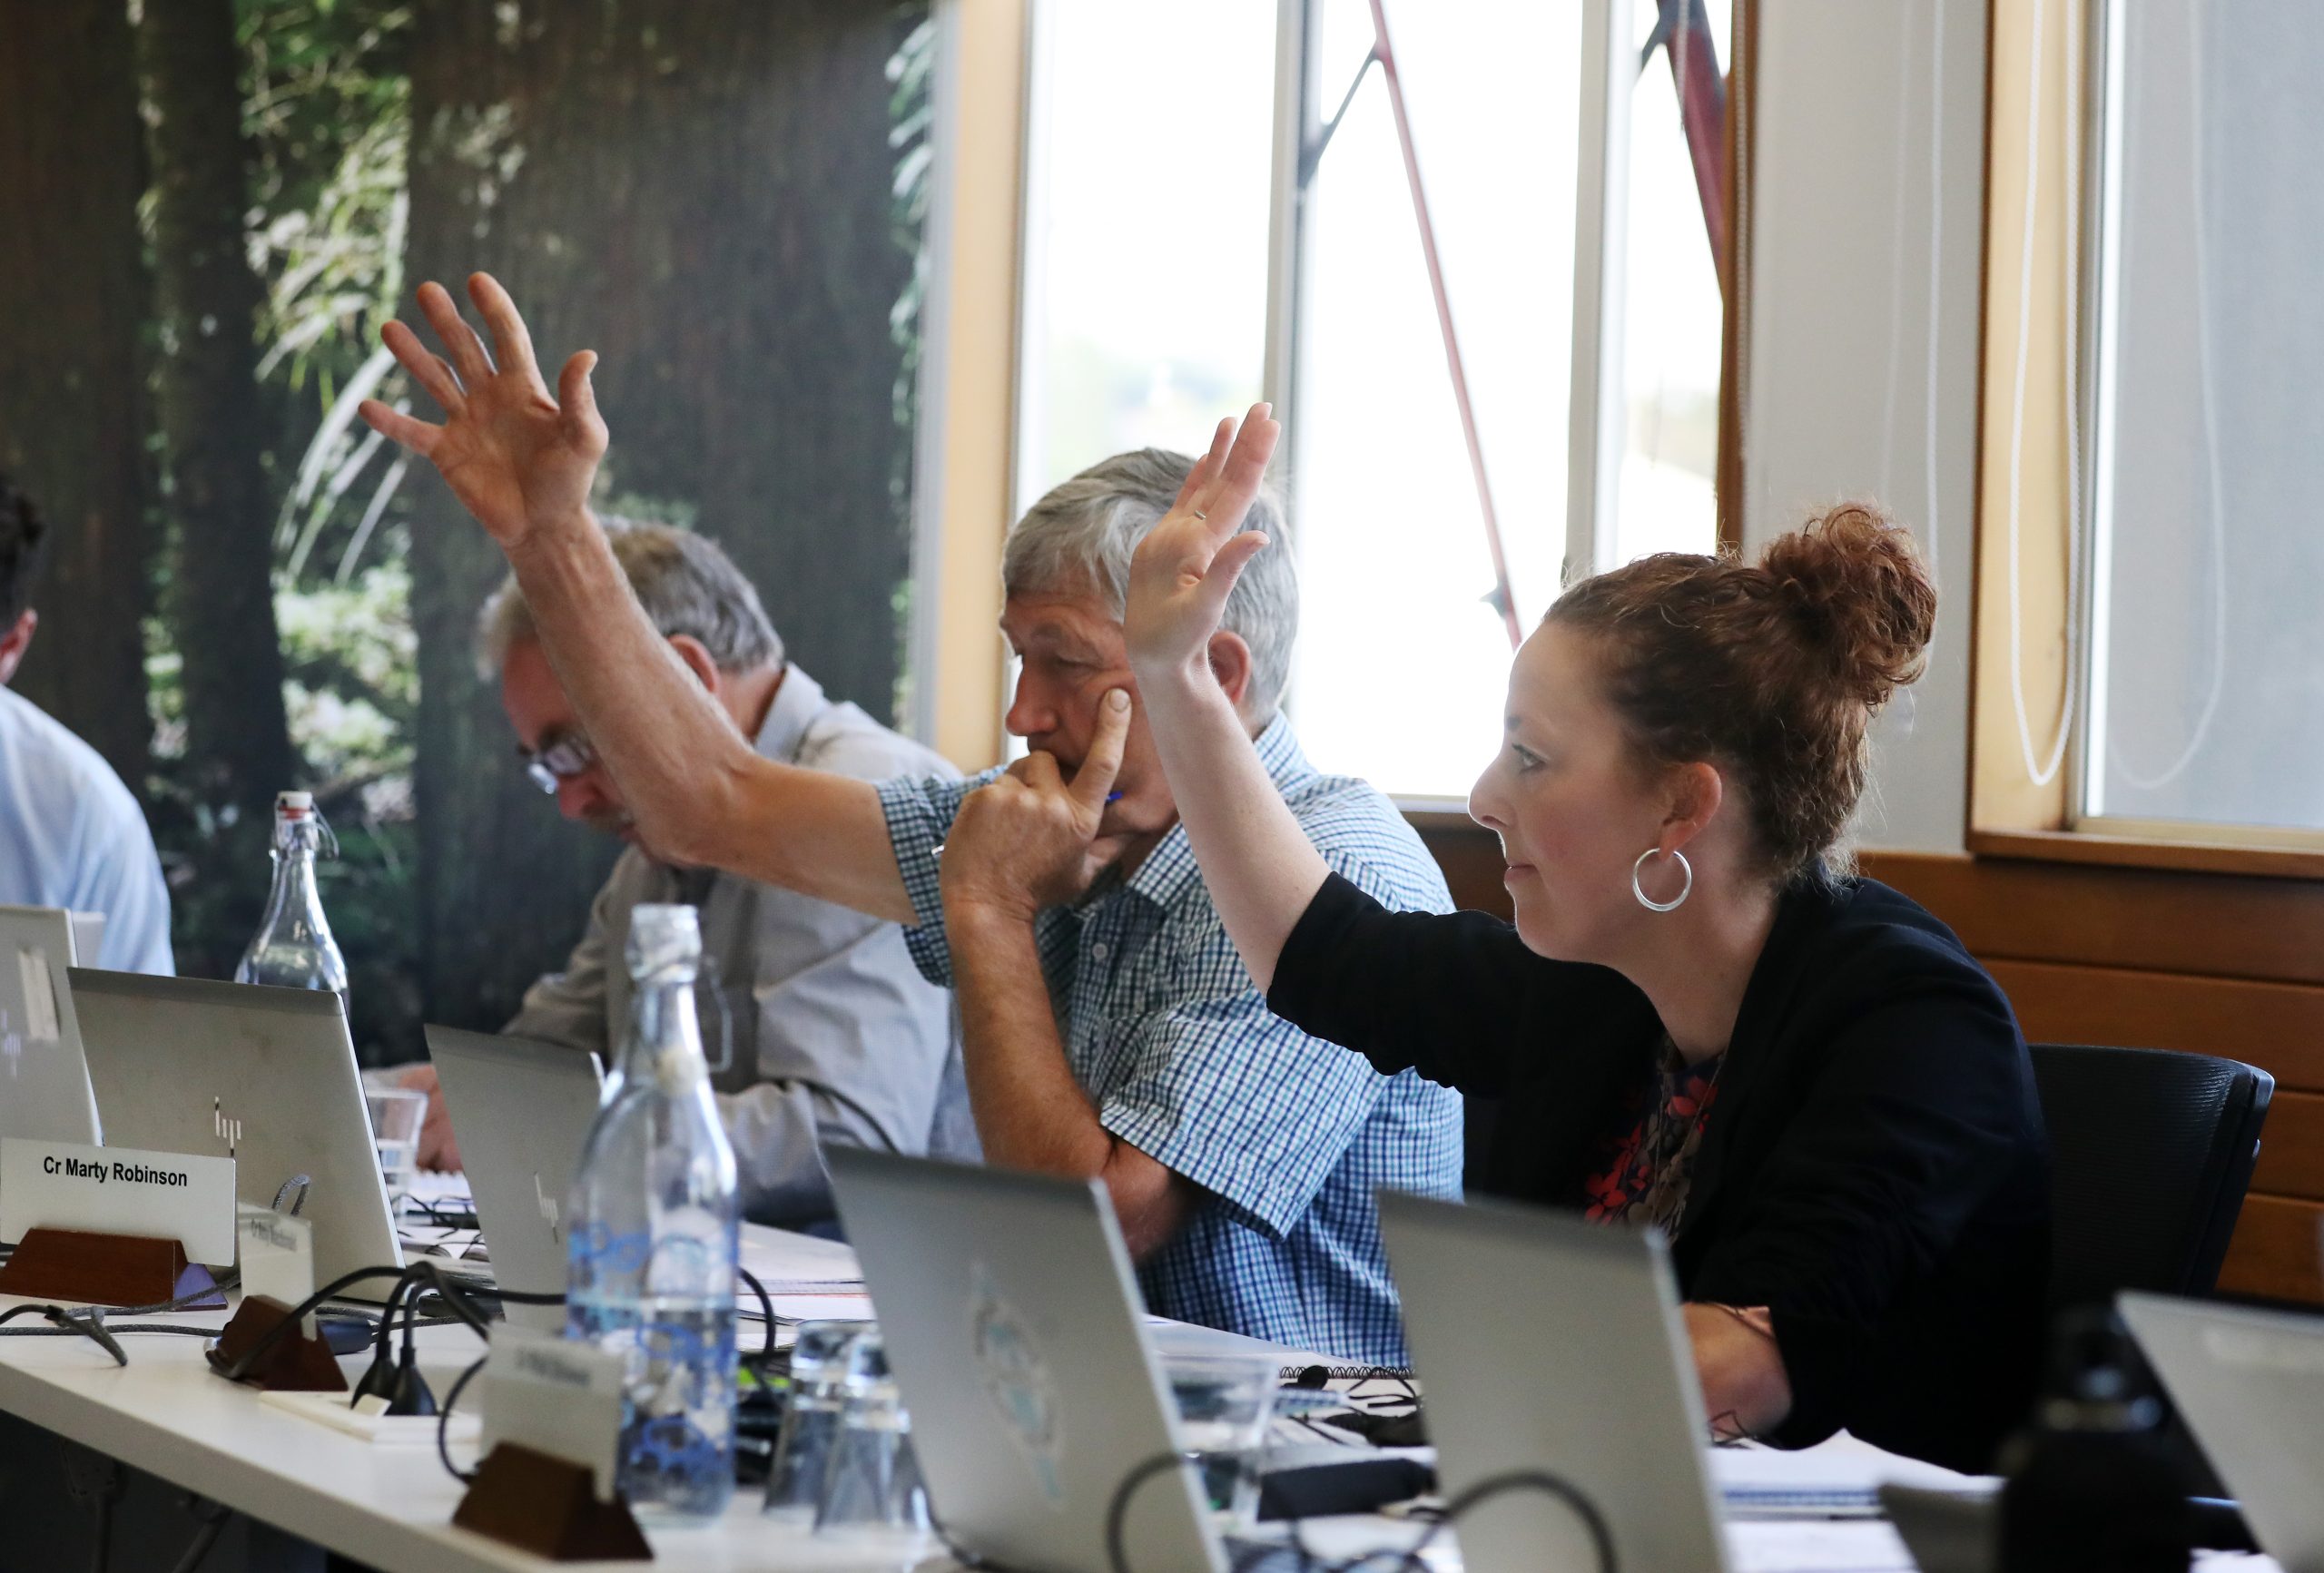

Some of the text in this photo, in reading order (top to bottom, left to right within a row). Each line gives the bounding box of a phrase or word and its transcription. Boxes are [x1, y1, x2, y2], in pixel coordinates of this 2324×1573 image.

[43, 1155, 187, 1186] Cr Marty Robinson
